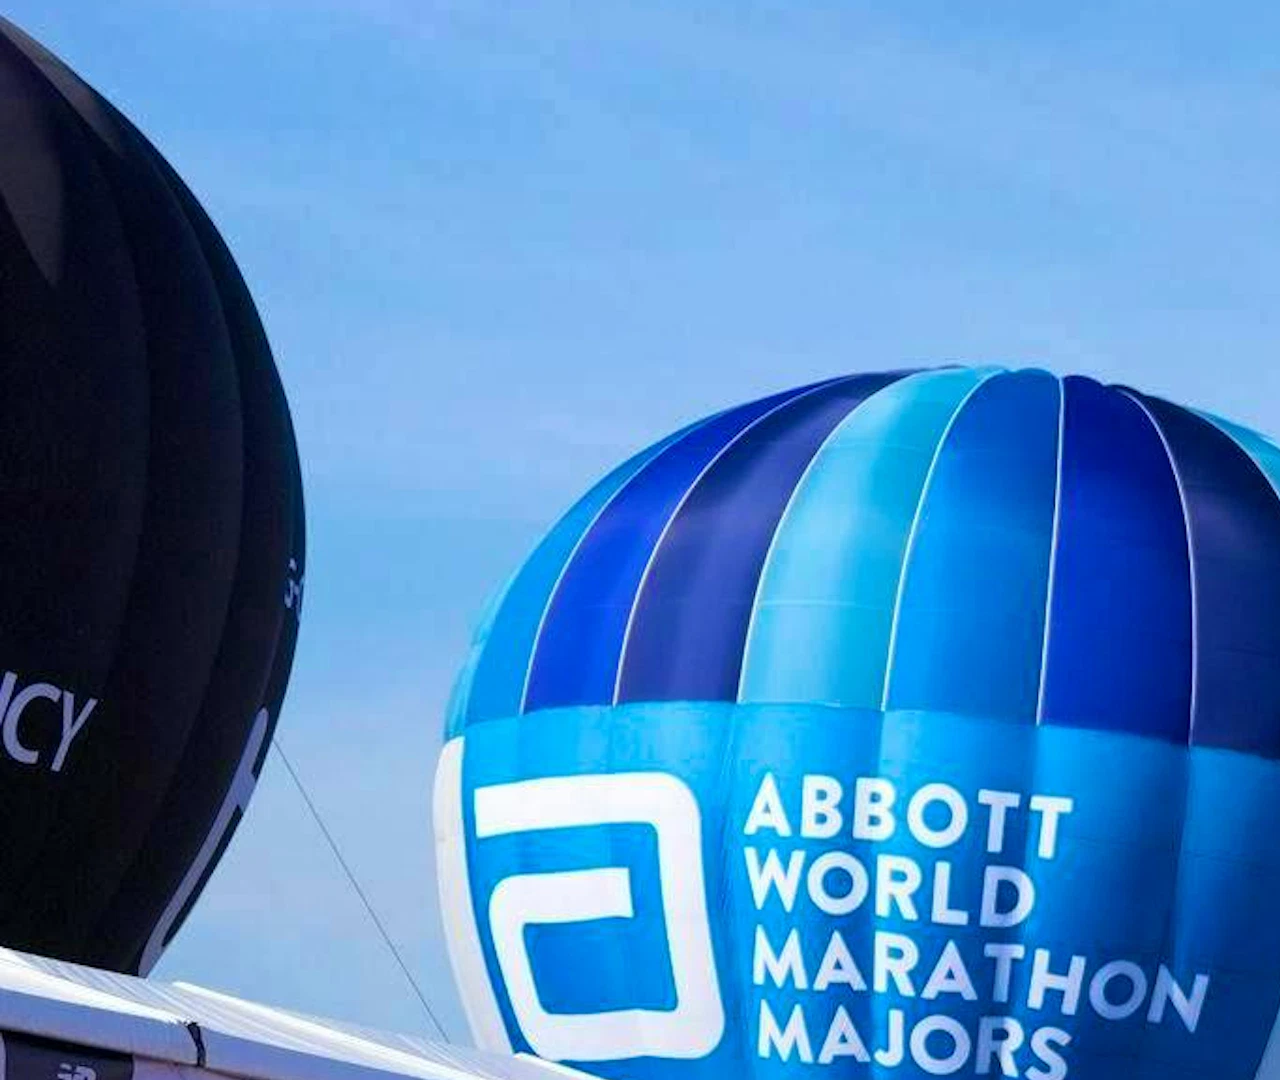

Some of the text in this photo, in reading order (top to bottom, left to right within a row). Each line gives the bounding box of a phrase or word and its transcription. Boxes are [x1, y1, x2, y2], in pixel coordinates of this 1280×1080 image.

[744, 772, 1073, 859] ABBOTT
[744, 846, 1035, 928] WORLD
[752, 925, 1209, 1033] MARATHON
